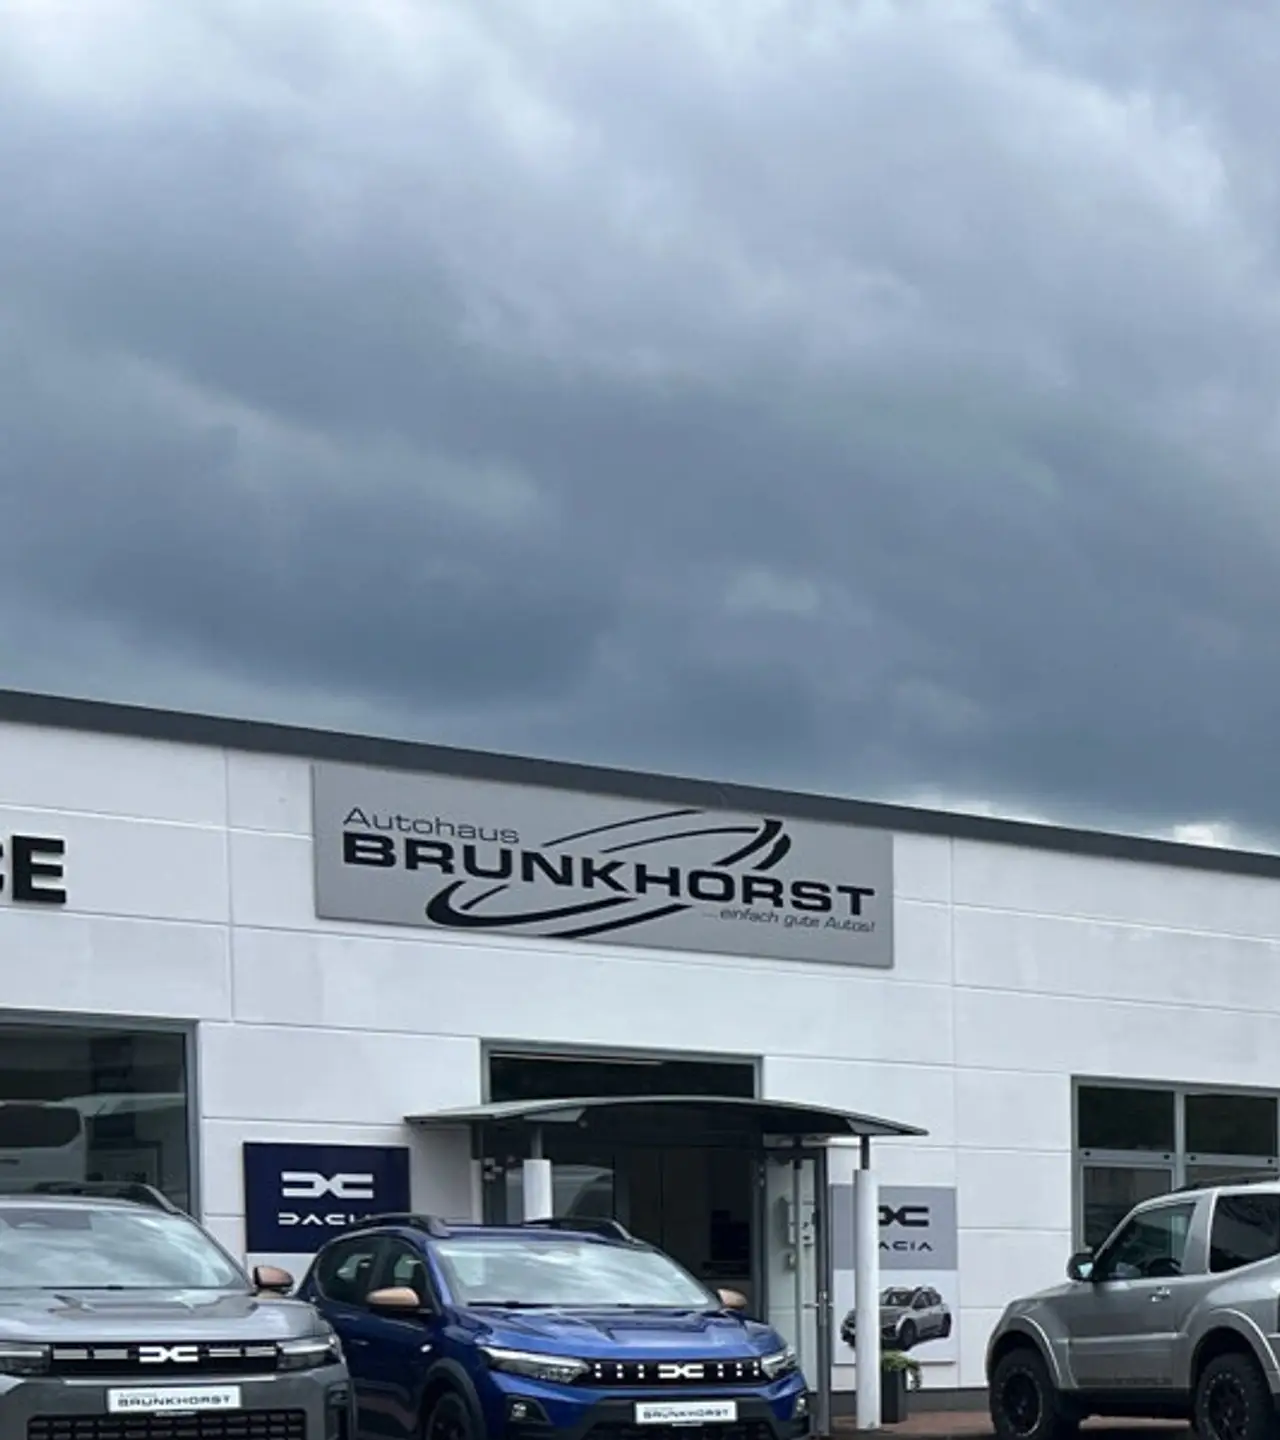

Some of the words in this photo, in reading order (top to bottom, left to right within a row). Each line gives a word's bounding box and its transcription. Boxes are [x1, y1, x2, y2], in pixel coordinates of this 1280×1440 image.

[343, 806, 519, 844] Autohaus
[343, 831, 875, 916] BRUNKHORST
[784, 914, 820, 928] gute
[823, 916, 875, 932] Autos!
